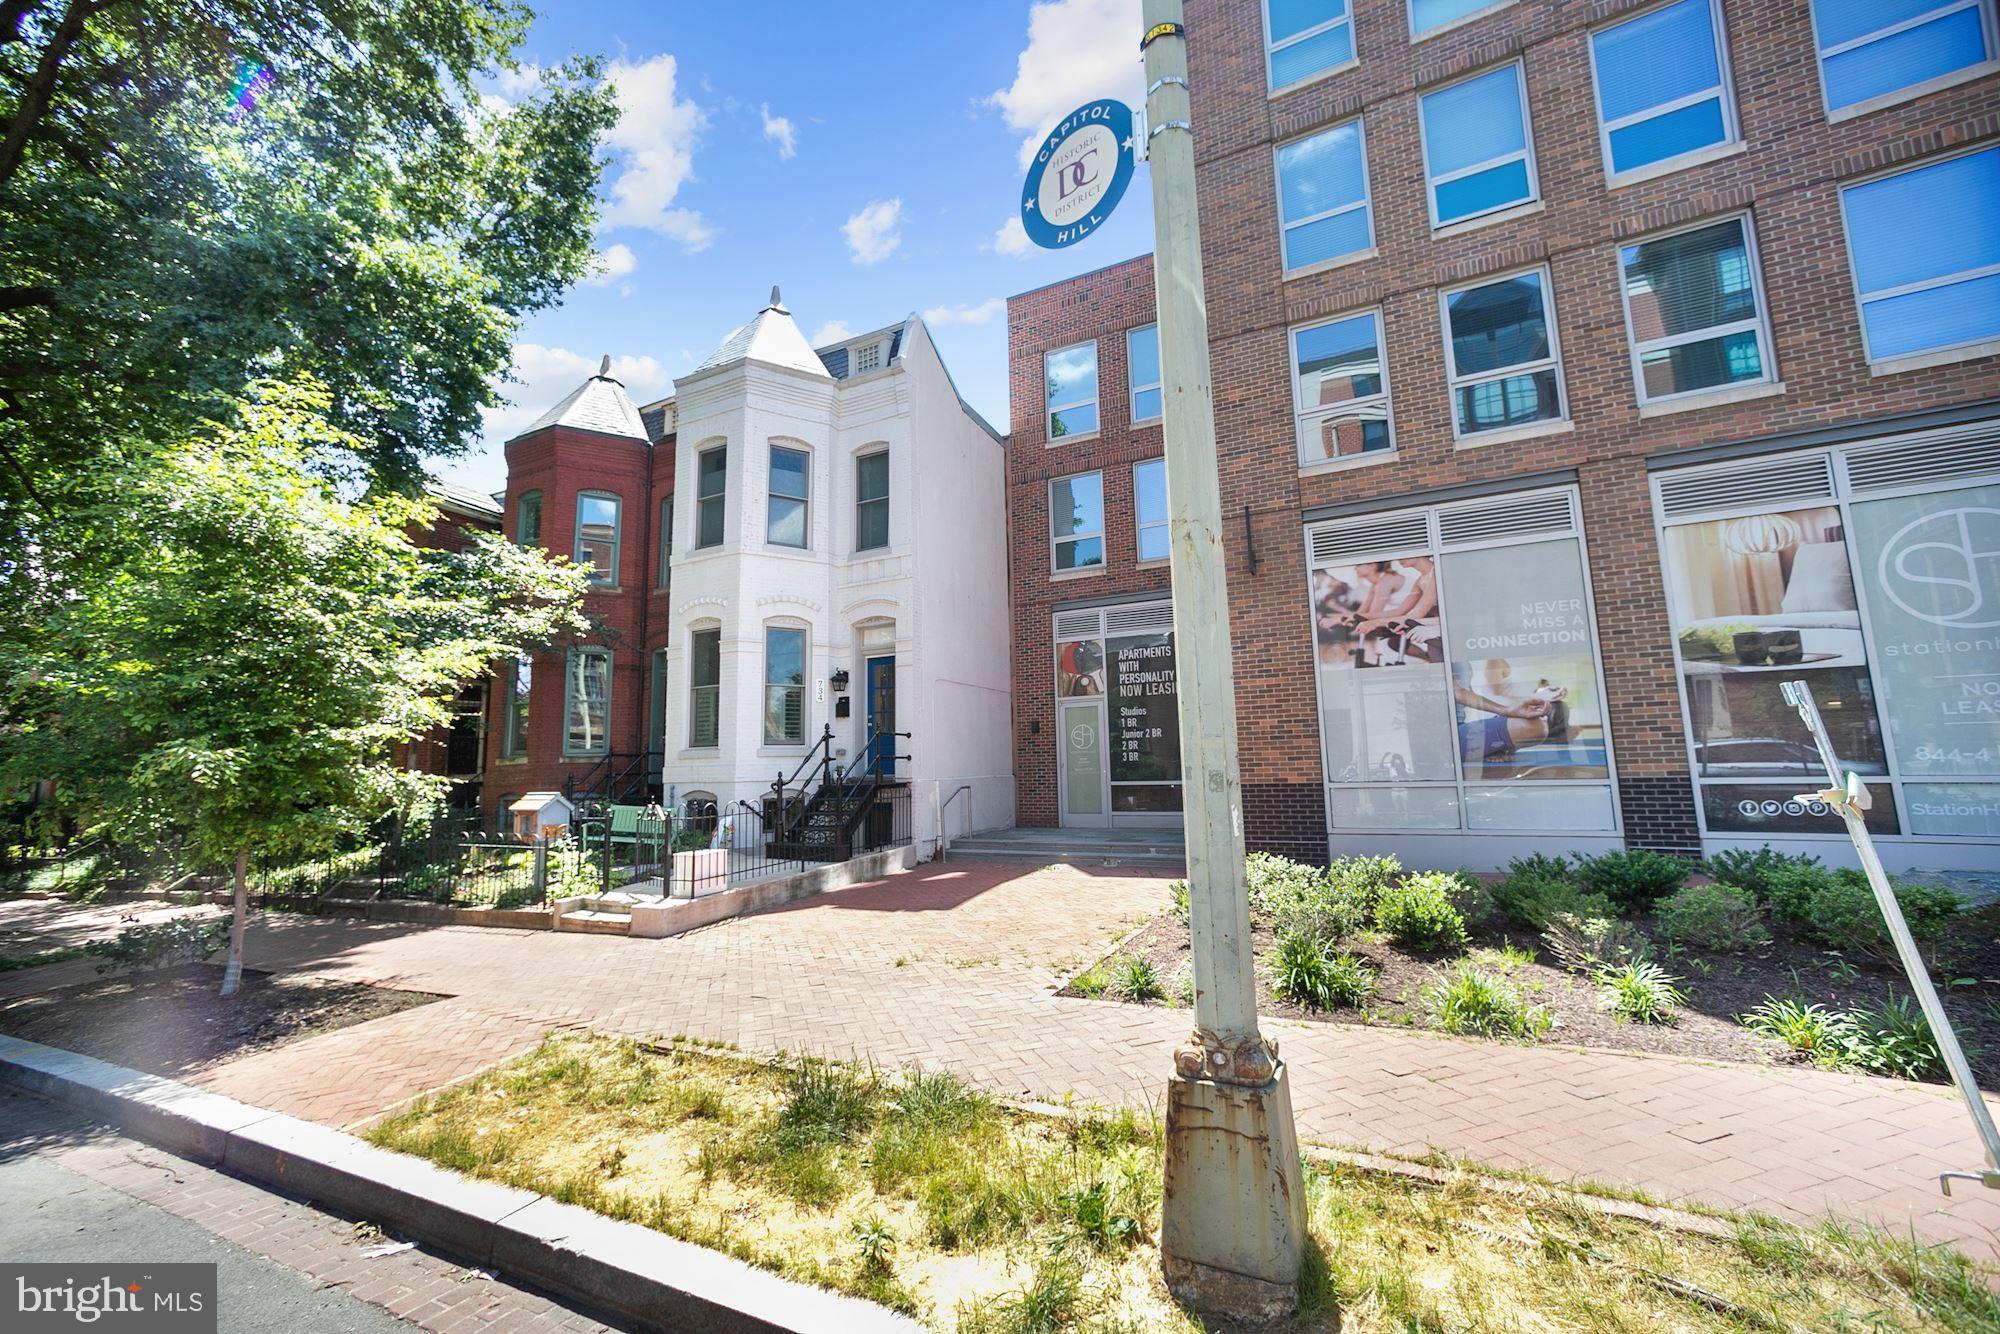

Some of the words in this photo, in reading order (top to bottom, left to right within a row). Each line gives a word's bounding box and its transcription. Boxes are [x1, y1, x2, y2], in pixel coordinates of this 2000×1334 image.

[1039, 105, 1111, 163] CAPITOL
[1052, 131, 1101, 169] HISTORIC
[1056, 148, 1099, 201] DC
[1054, 183, 1102, 218] DISTRICT
[1057, 214, 1102, 243] HILL
[1520, 599, 1581, 615] NEVER
[1522, 615, 1567, 630] MISS
[1572, 614, 1584, 626] A
[1465, 629, 1585, 650] CONNECTION
[1118, 645, 1172, 660] APARTMENTS
[1119, 661, 1139, 672] WITH
[1120, 670, 1175, 684] PERSONALITY
[1120, 684, 1142, 697] NOW
[1120, 706, 1147, 716] Studios
[1121, 718, 1125, 727] 1
[1127, 718, 1137, 727] BR
[1121, 729, 1144, 739] Junior
[1145, 729, 1150, 738] 2
[1151, 728, 1162, 738] BR
[1122, 741, 1127, 750] 2
[1128, 740, 1139, 750] BR
[1122, 752, 1127, 761] 3
[1128, 752, 1139, 761] BR
[1915, 745, 2000, 762] 844-4
